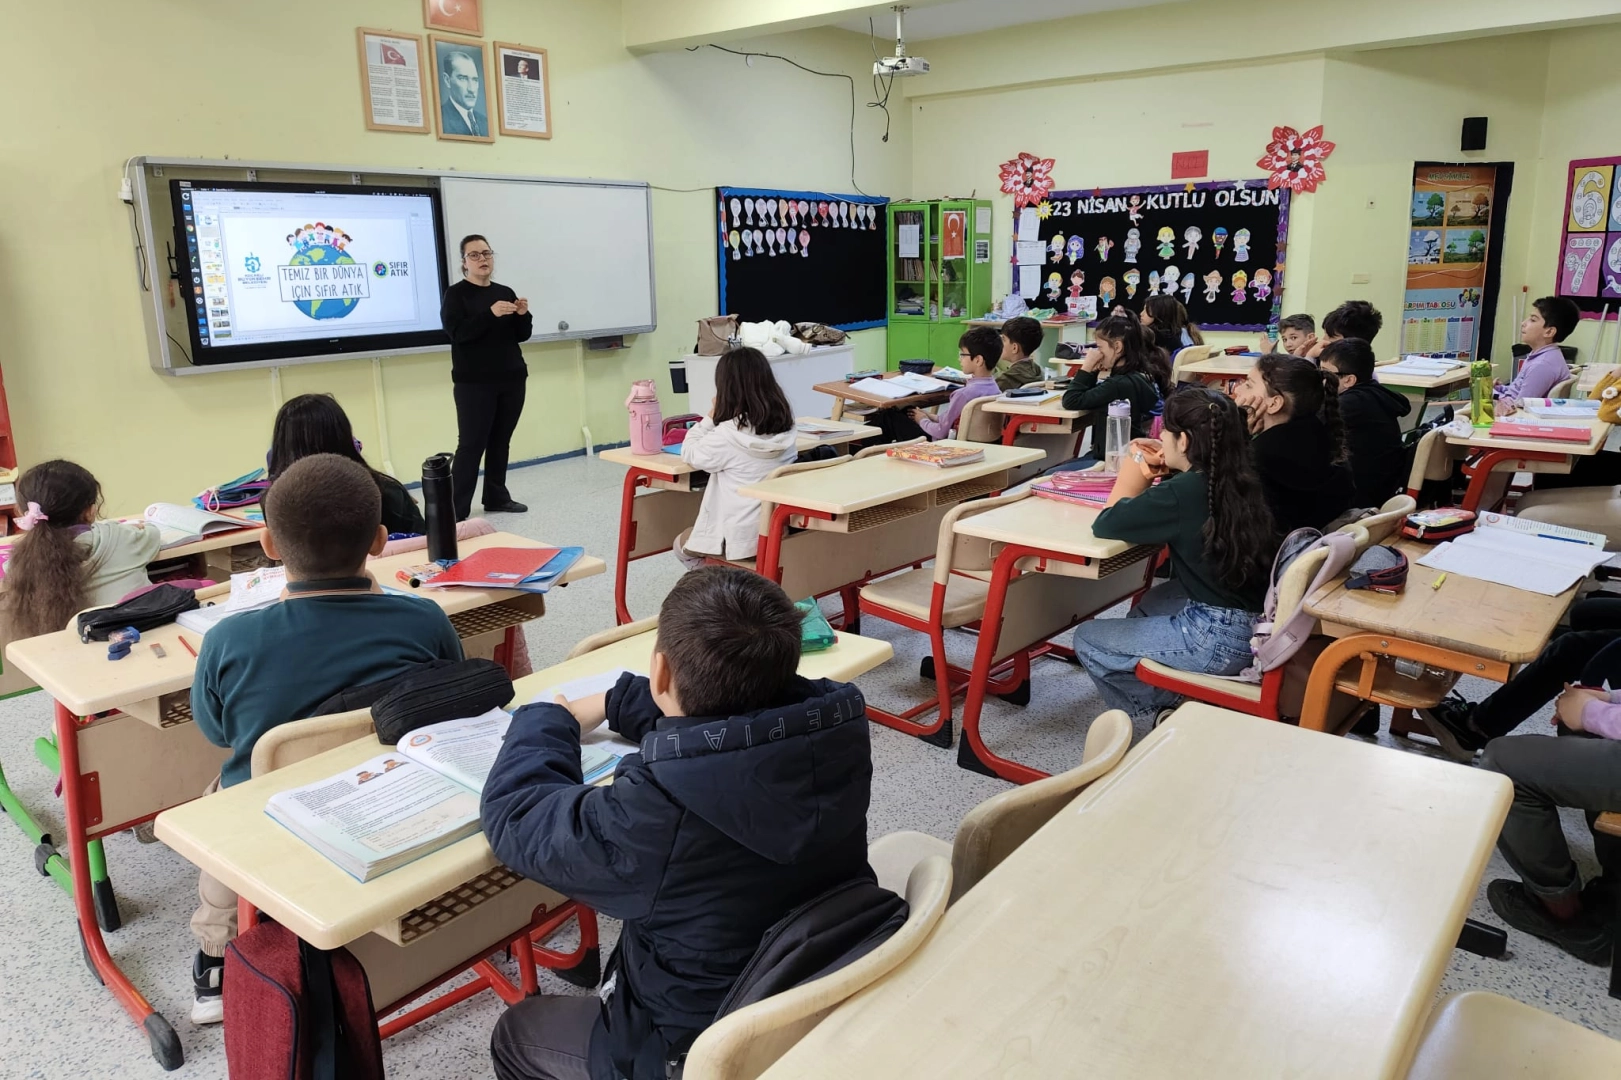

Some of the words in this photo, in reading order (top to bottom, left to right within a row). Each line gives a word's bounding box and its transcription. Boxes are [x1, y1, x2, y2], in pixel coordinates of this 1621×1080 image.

[1052, 201, 1072, 217] 23
[1077, 196, 1127, 214] NİSAN
[1147, 192, 1206, 210] KUTLU
[1215, 189, 1280, 206] OLSUN
[1572, 171, 1605, 228] 6
[333, 266, 364, 280] DÜNYA
[390, 269, 409, 277] ATIK
[1569, 237, 1603, 293] 7
[1426, 301, 1456, 309] TABLOSU
